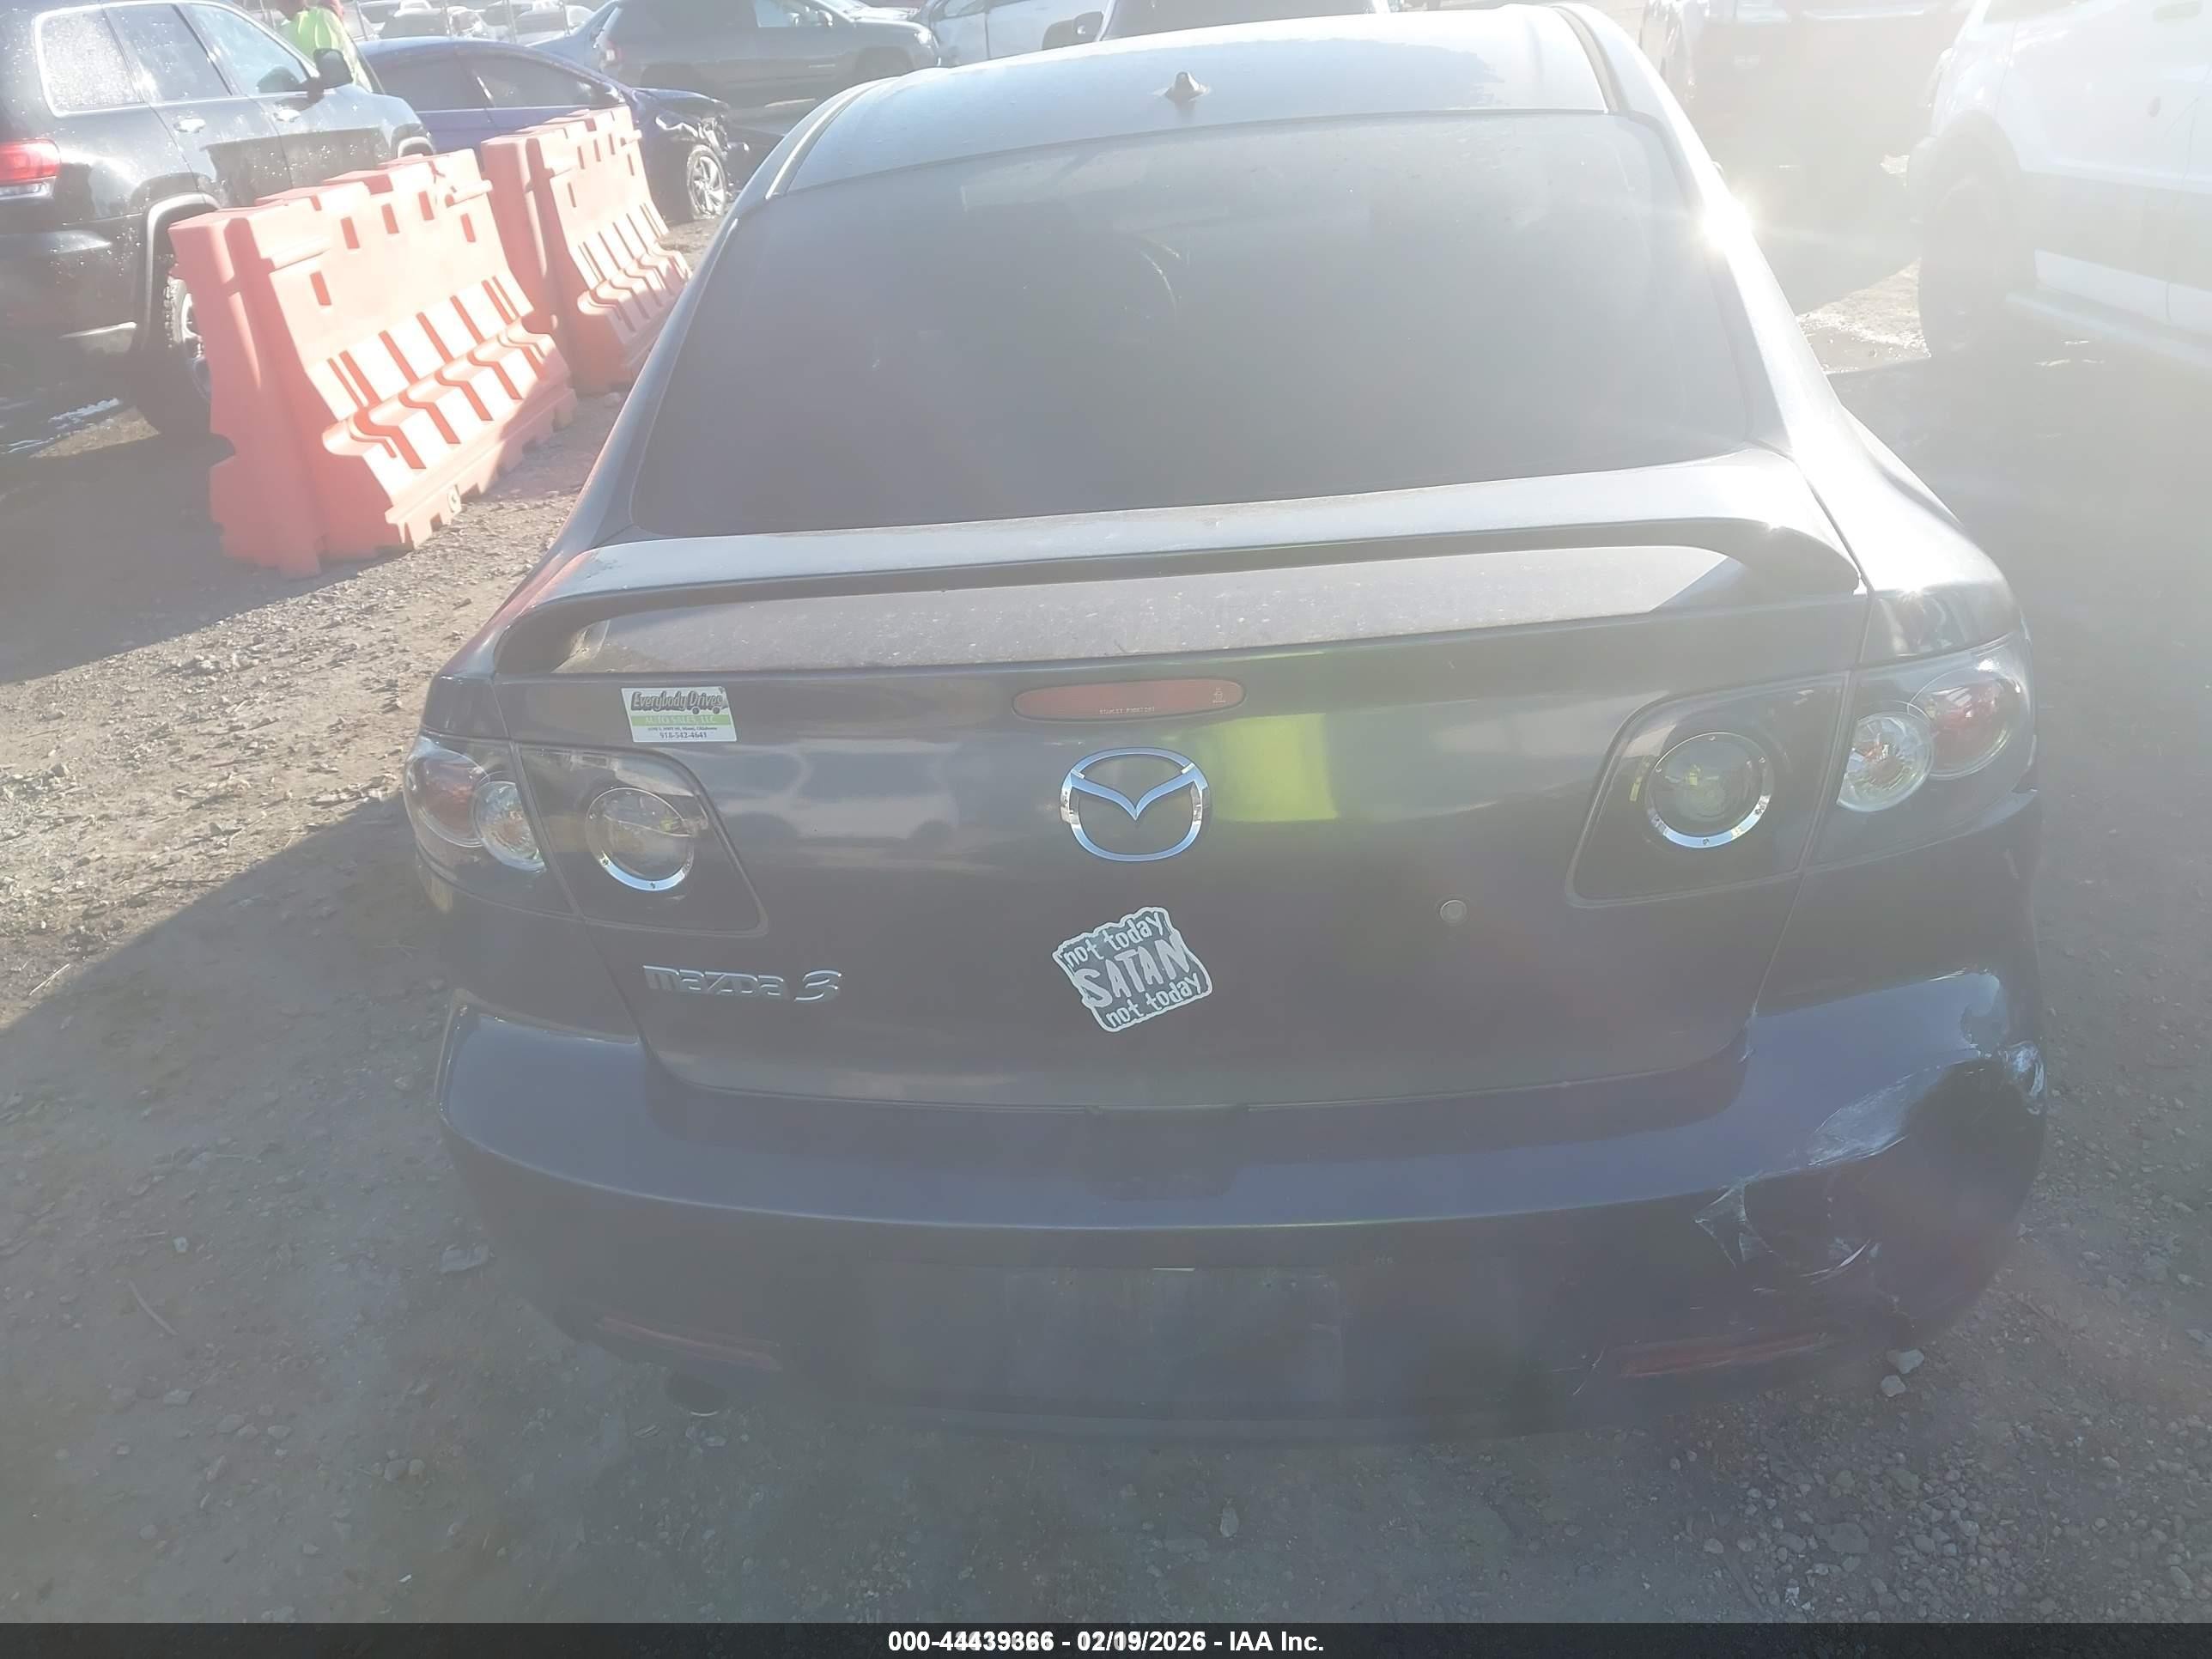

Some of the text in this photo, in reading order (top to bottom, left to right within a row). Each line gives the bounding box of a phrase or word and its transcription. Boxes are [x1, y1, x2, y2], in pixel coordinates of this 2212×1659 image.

[631, 690, 723, 711] Everybody Drives
[645, 715, 669, 725] AUTO
[701, 714, 715, 724] LLC
[1062, 912, 1164, 969] not today
[793, 969, 842, 1002] 3
[1073, 928, 1190, 1008] SATAN
[1105, 972, 1201, 1028] not today
